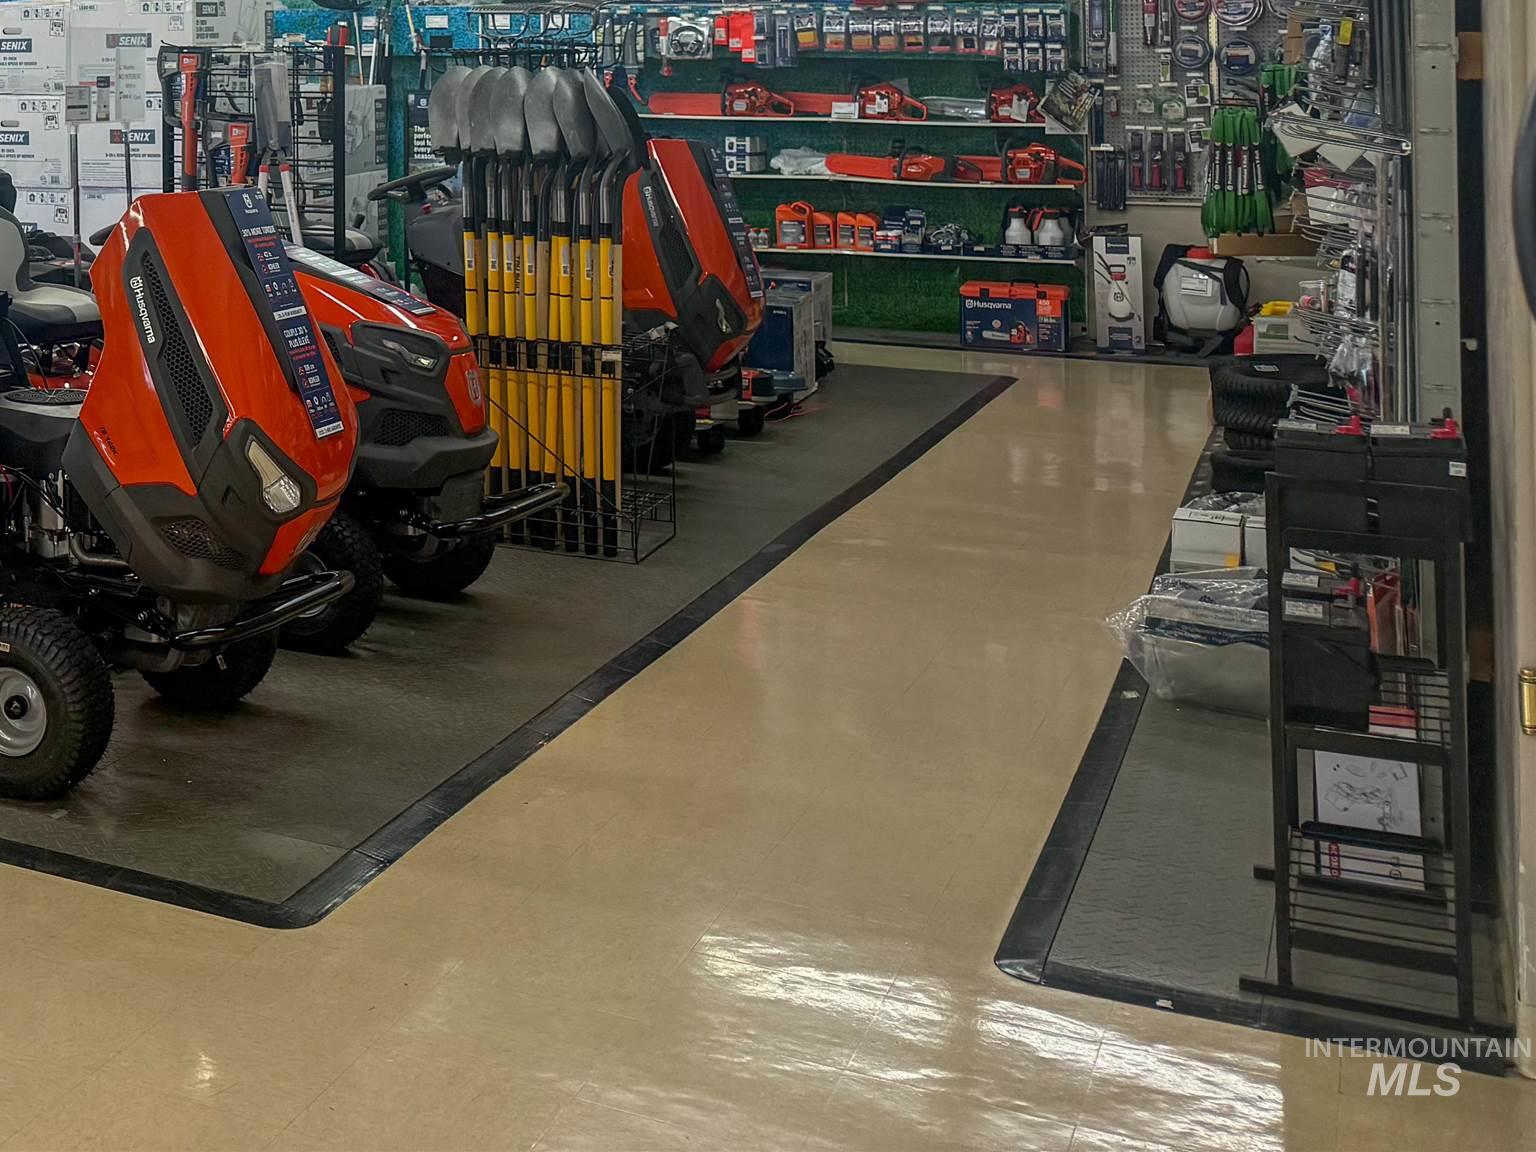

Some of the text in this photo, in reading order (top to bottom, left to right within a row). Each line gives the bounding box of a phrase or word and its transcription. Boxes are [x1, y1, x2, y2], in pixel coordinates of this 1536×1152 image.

[1, 41, 27, 50] SENIX
[119, 36, 148, 46] SENIX
[0, 133, 24, 143] SENIX
[122, 132, 151, 142] ENIX
[973, 299, 1012, 309] Husqvarna
[133, 287, 156, 344] Husqvarna
